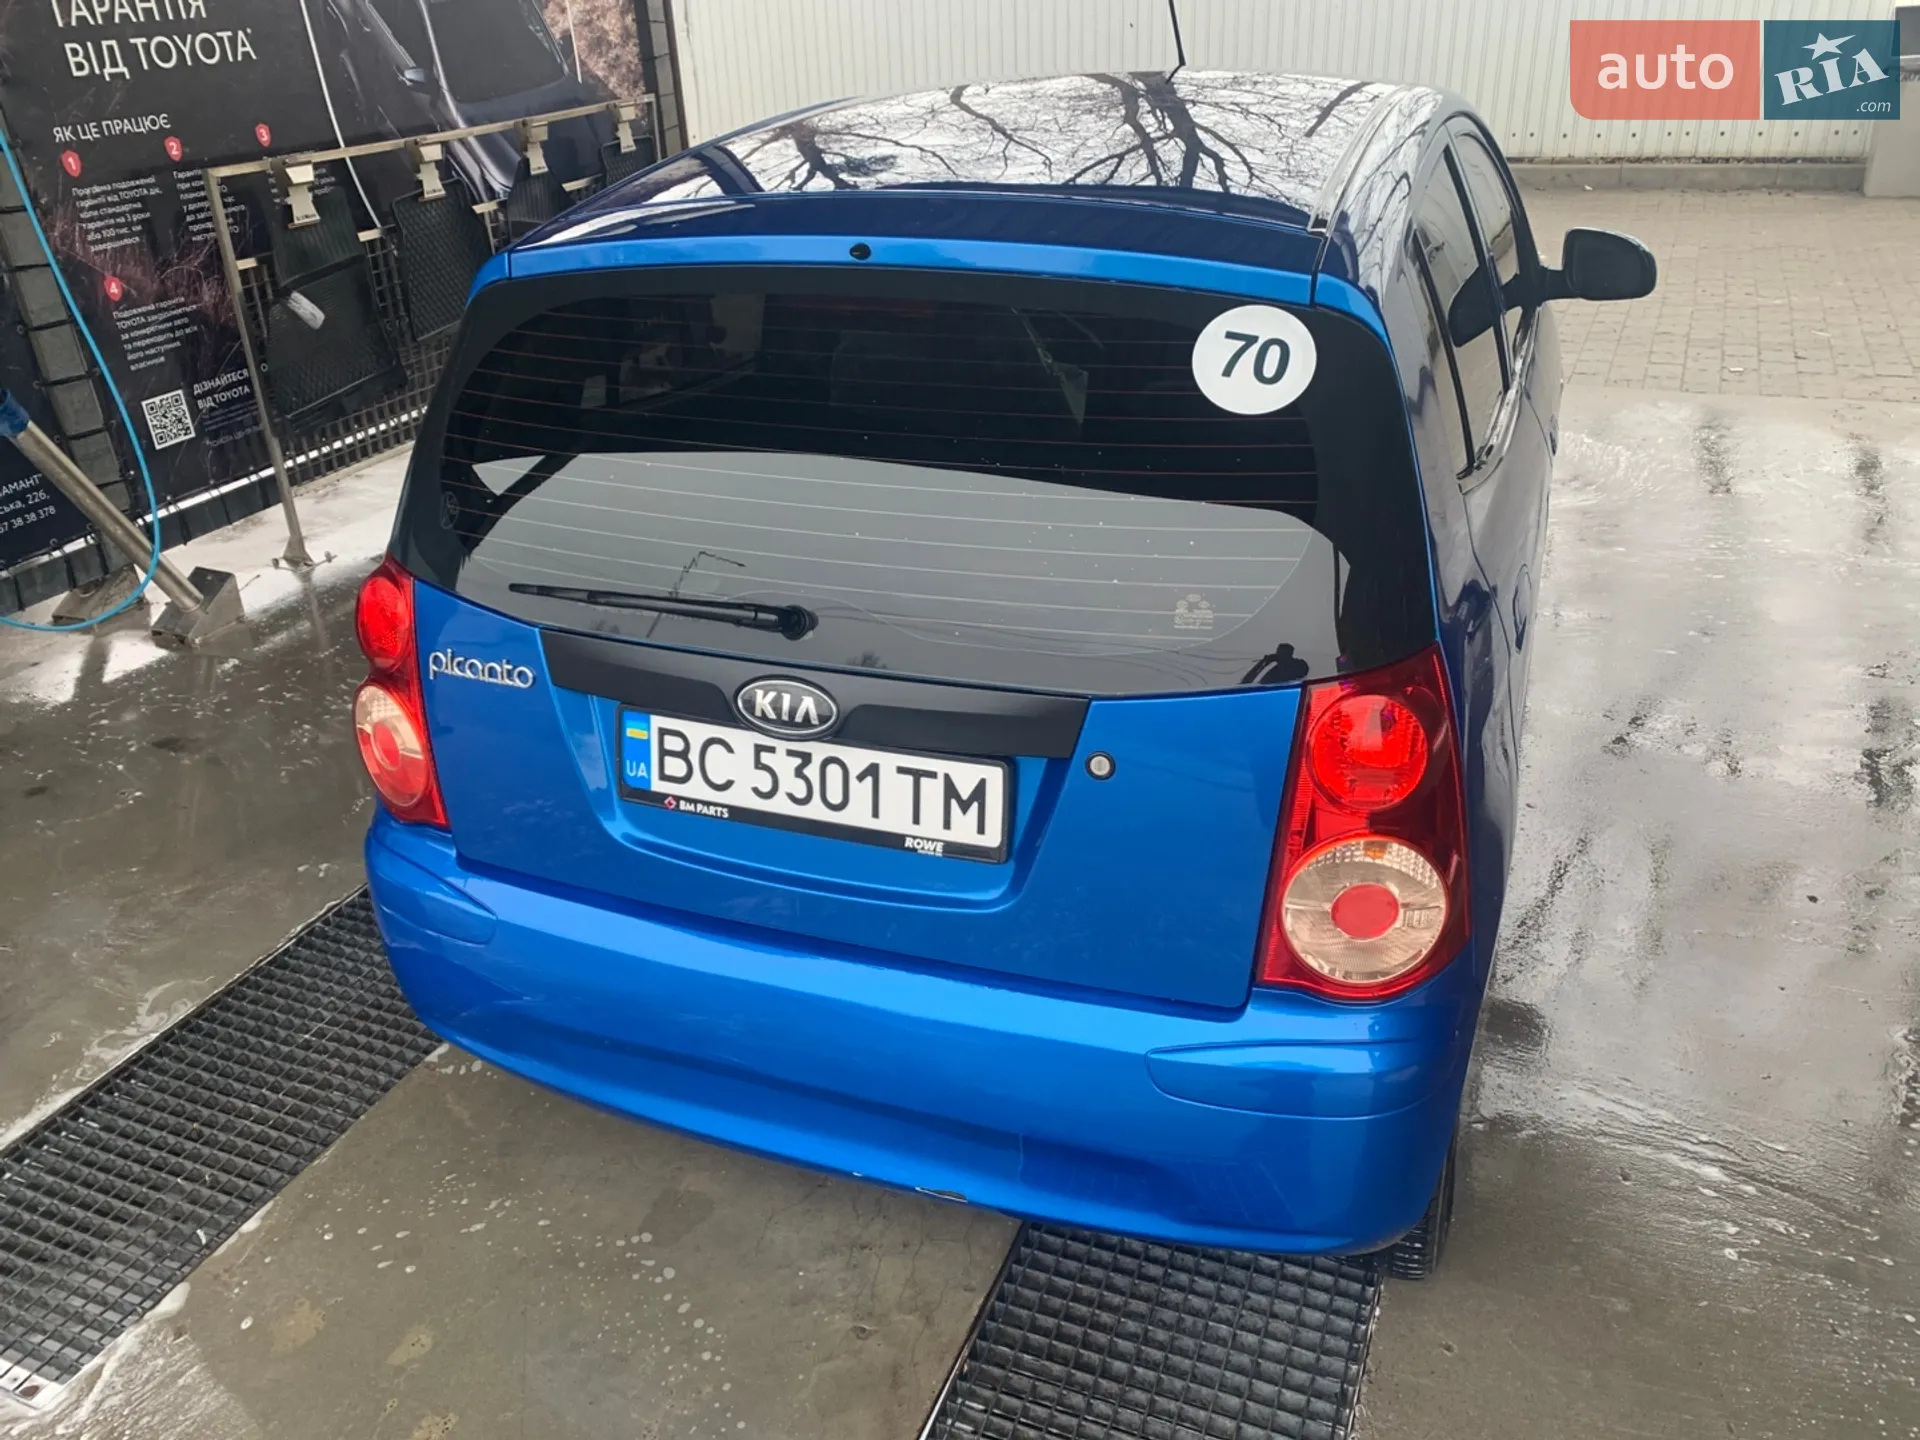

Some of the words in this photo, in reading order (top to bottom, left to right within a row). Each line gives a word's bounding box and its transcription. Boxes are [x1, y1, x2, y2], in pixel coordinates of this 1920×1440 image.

[64, 40, 130, 82] ВІД
[53, 125, 75, 144] ЯК
[79, 121, 101, 142] ЦЕ
[102, 113, 173, 137] ПРАЦЮЄ
[119, 188, 149, 199] TOYOTA
[116, 316, 147, 330] TOYOTA
[1220, 330, 1291, 386] 70
[193, 368, 249, 396] ДІЗНАЙТЕСЯ
[197, 396, 215, 410] ВІД
[213, 384, 250, 403] TOYOTA
[26, 488, 50, 505] 226,
[10, 516, 24, 529] 38
[24, 511, 37, 524] 38
[37, 505, 56, 519] 378
[429, 648, 537, 689] picanto
[753, 688, 821, 726] KIA
[626, 760, 648, 778] UA
[657, 726, 736, 792] BC
[750, 743, 881, 820] 5301
[679, 799, 696, 812] BM
[696, 803, 730, 819] PARTS
[904, 836, 944, 852] ROWE
